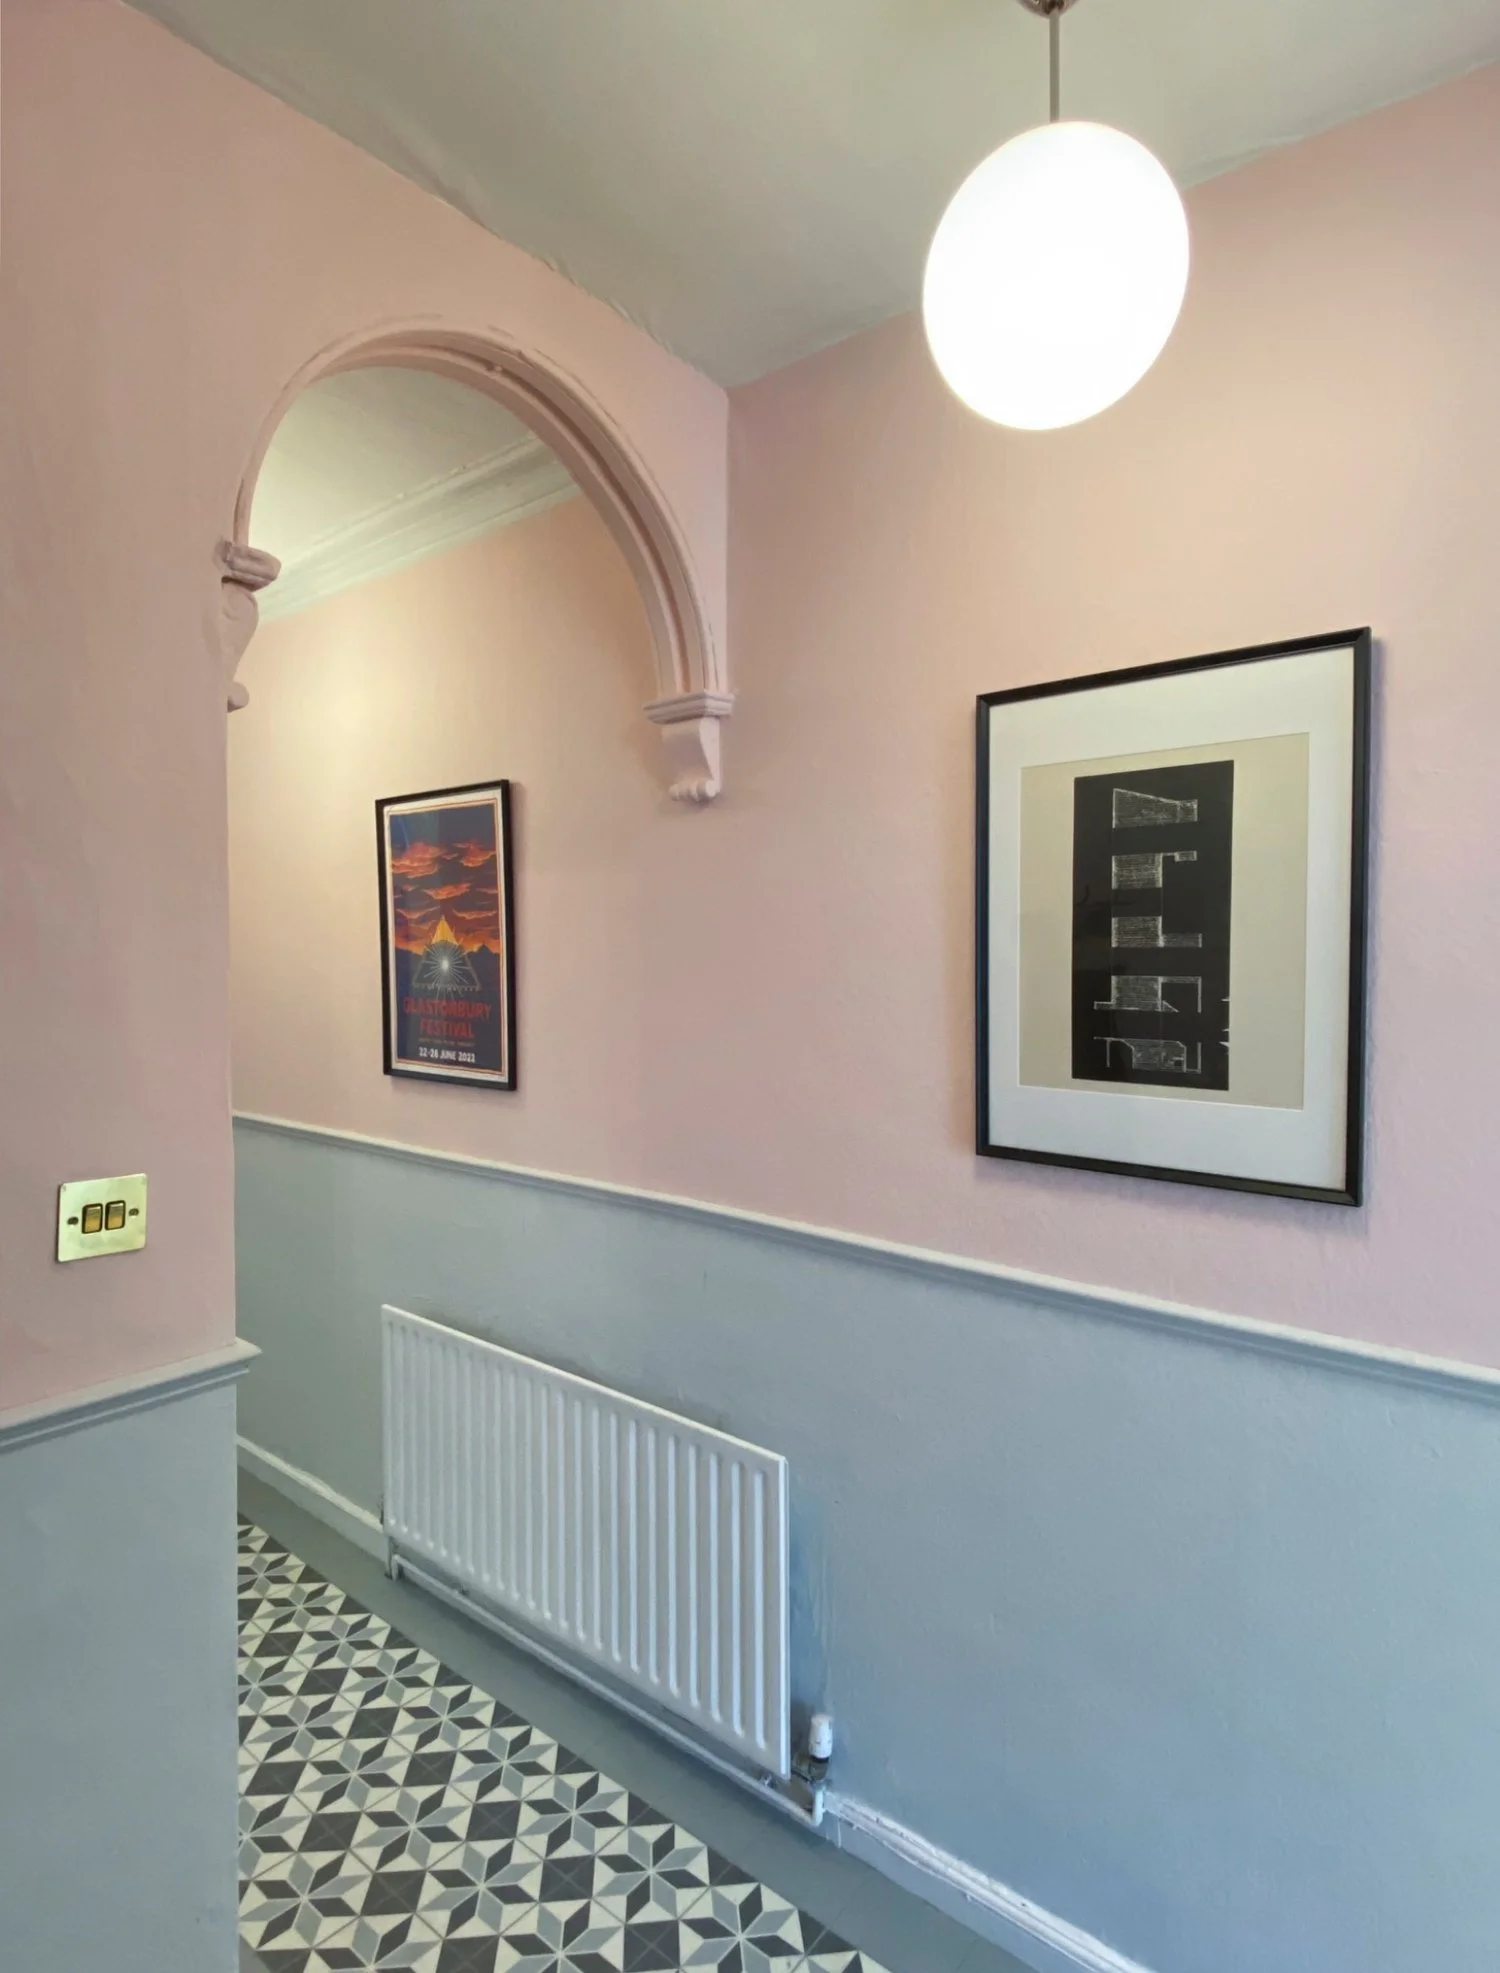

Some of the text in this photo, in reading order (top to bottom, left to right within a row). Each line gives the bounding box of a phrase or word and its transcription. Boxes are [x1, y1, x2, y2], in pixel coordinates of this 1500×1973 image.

[403, 997, 492, 1020] GLASTONBURY
[420, 1018, 475, 1038] FESTIVAL
[440, 1050, 456, 1060] JUNE
[458, 1051, 475, 1063] 2022
